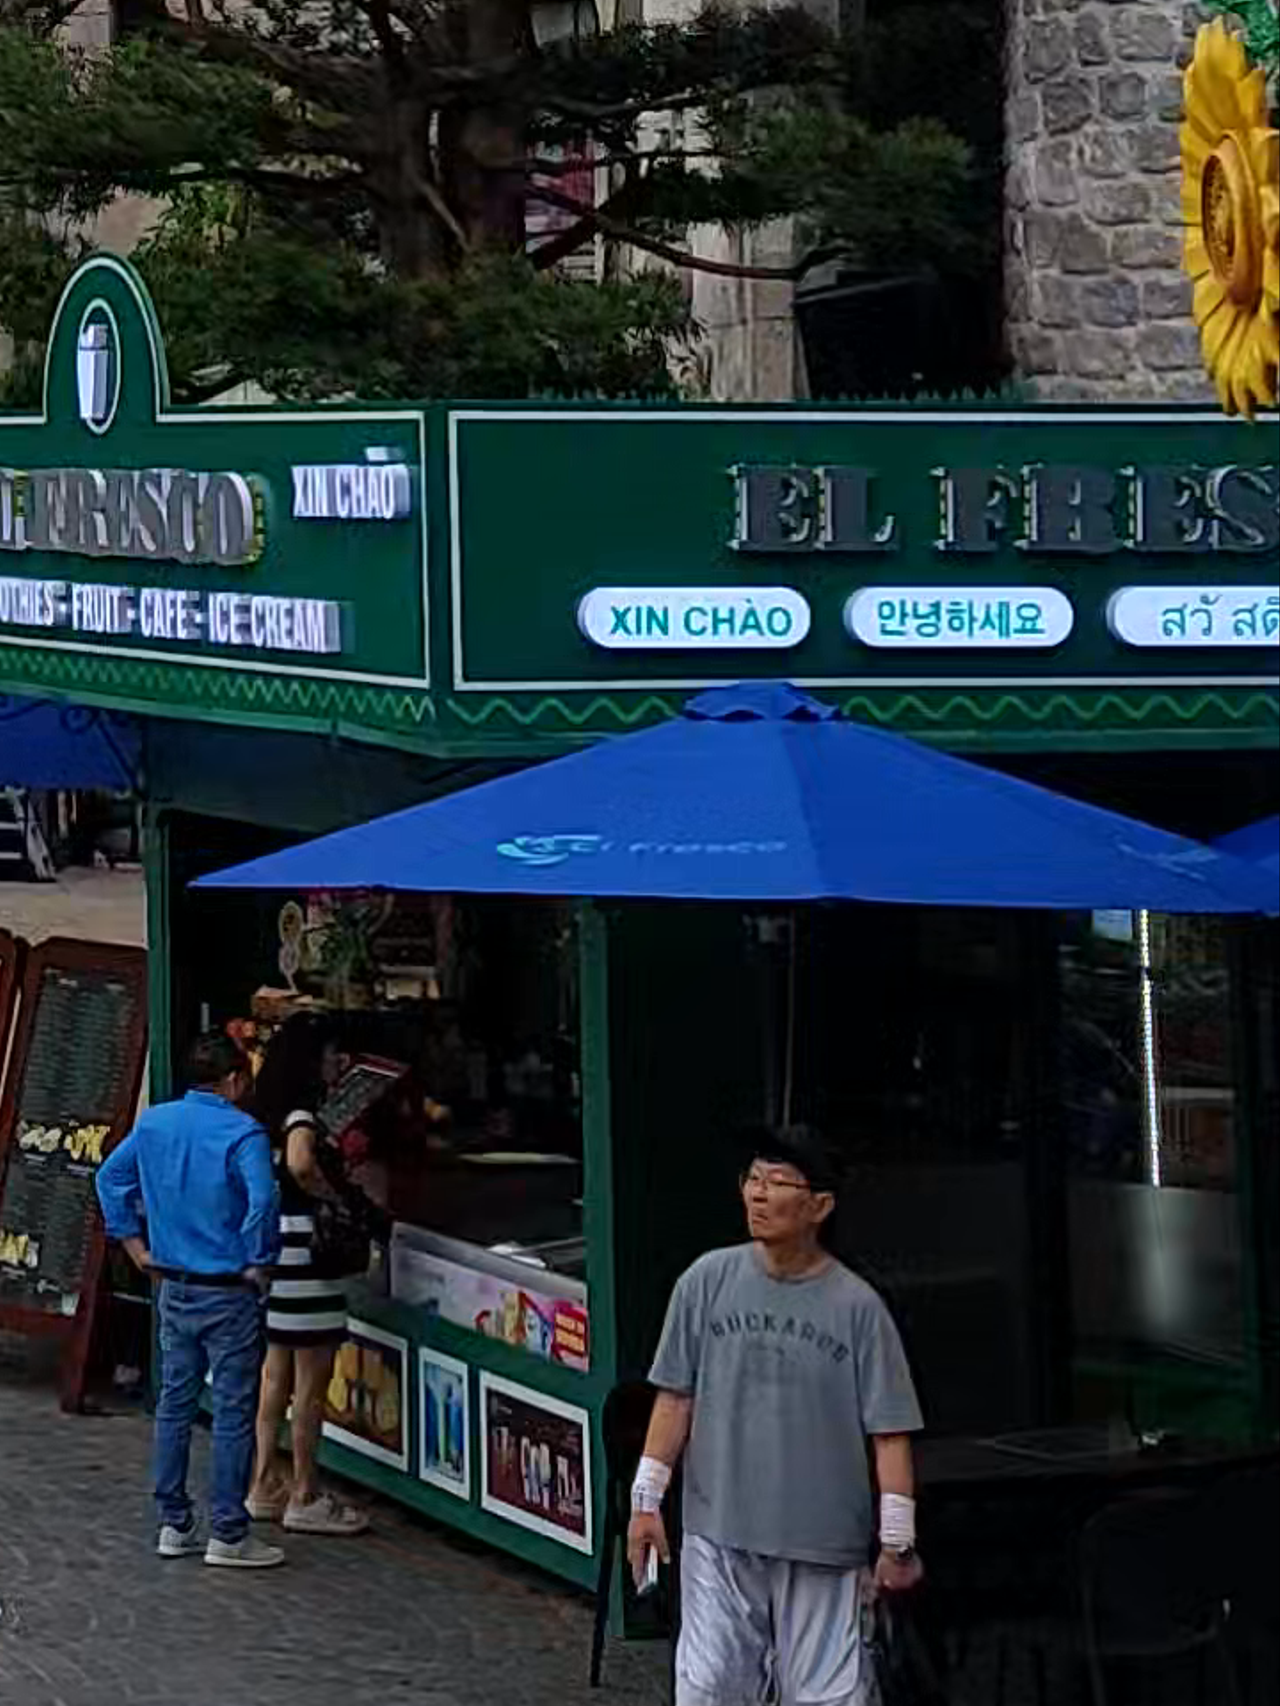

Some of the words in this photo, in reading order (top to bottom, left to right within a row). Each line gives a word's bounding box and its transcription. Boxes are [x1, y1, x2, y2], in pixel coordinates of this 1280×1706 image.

[291, 466, 329, 517] XIN
[726, 462, 900, 552] EL
[72, 582, 122, 634] FRUIT
[141, 587, 190, 640] CAFE
[208, 592, 246, 645] ICE
[250, 595, 334, 653] CREAM
[609, 606, 670, 636] XIN
[683, 598, 792, 637] CHÀO
[878, 599, 1046, 639] 안녕하세요
